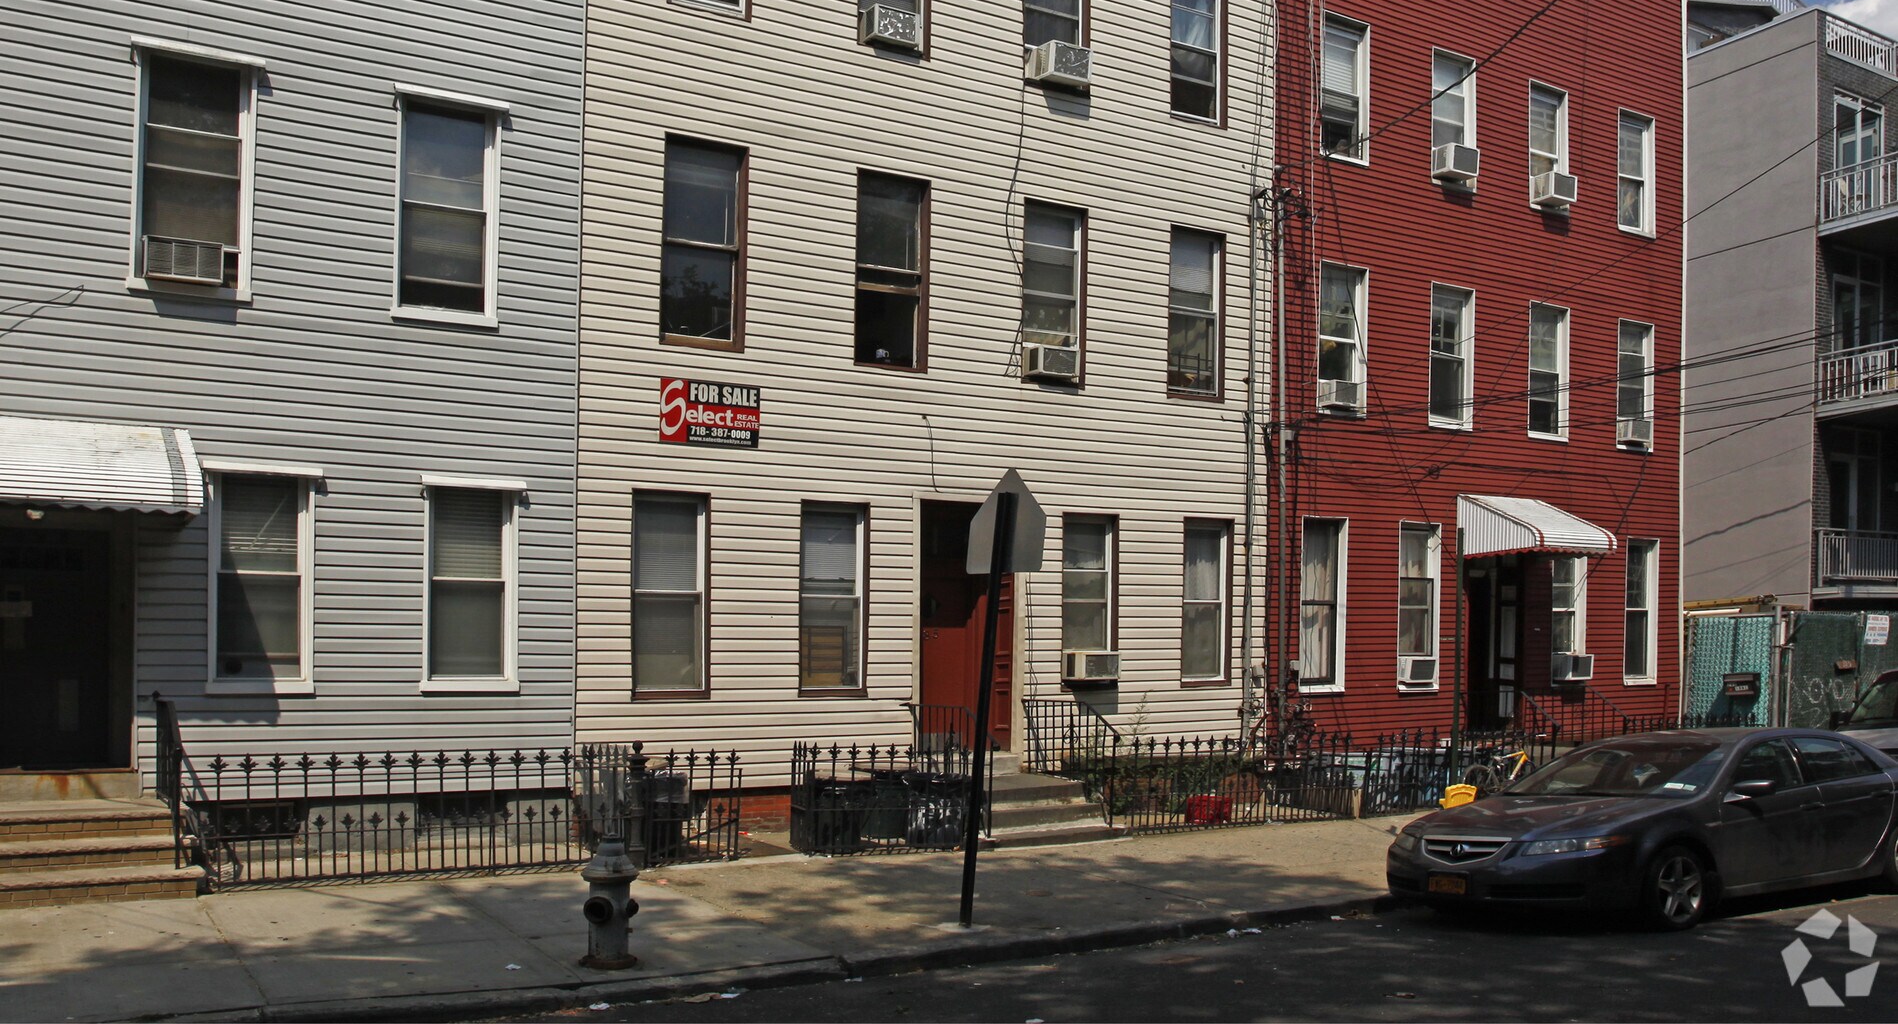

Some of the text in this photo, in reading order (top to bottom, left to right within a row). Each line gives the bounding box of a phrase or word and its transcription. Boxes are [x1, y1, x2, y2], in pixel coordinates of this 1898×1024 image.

[690, 383, 757, 407] FOR SALE
[661, 380, 734, 436] Select
[734, 420, 759, 429] ESTATE
[736, 414, 758, 422] REAL
